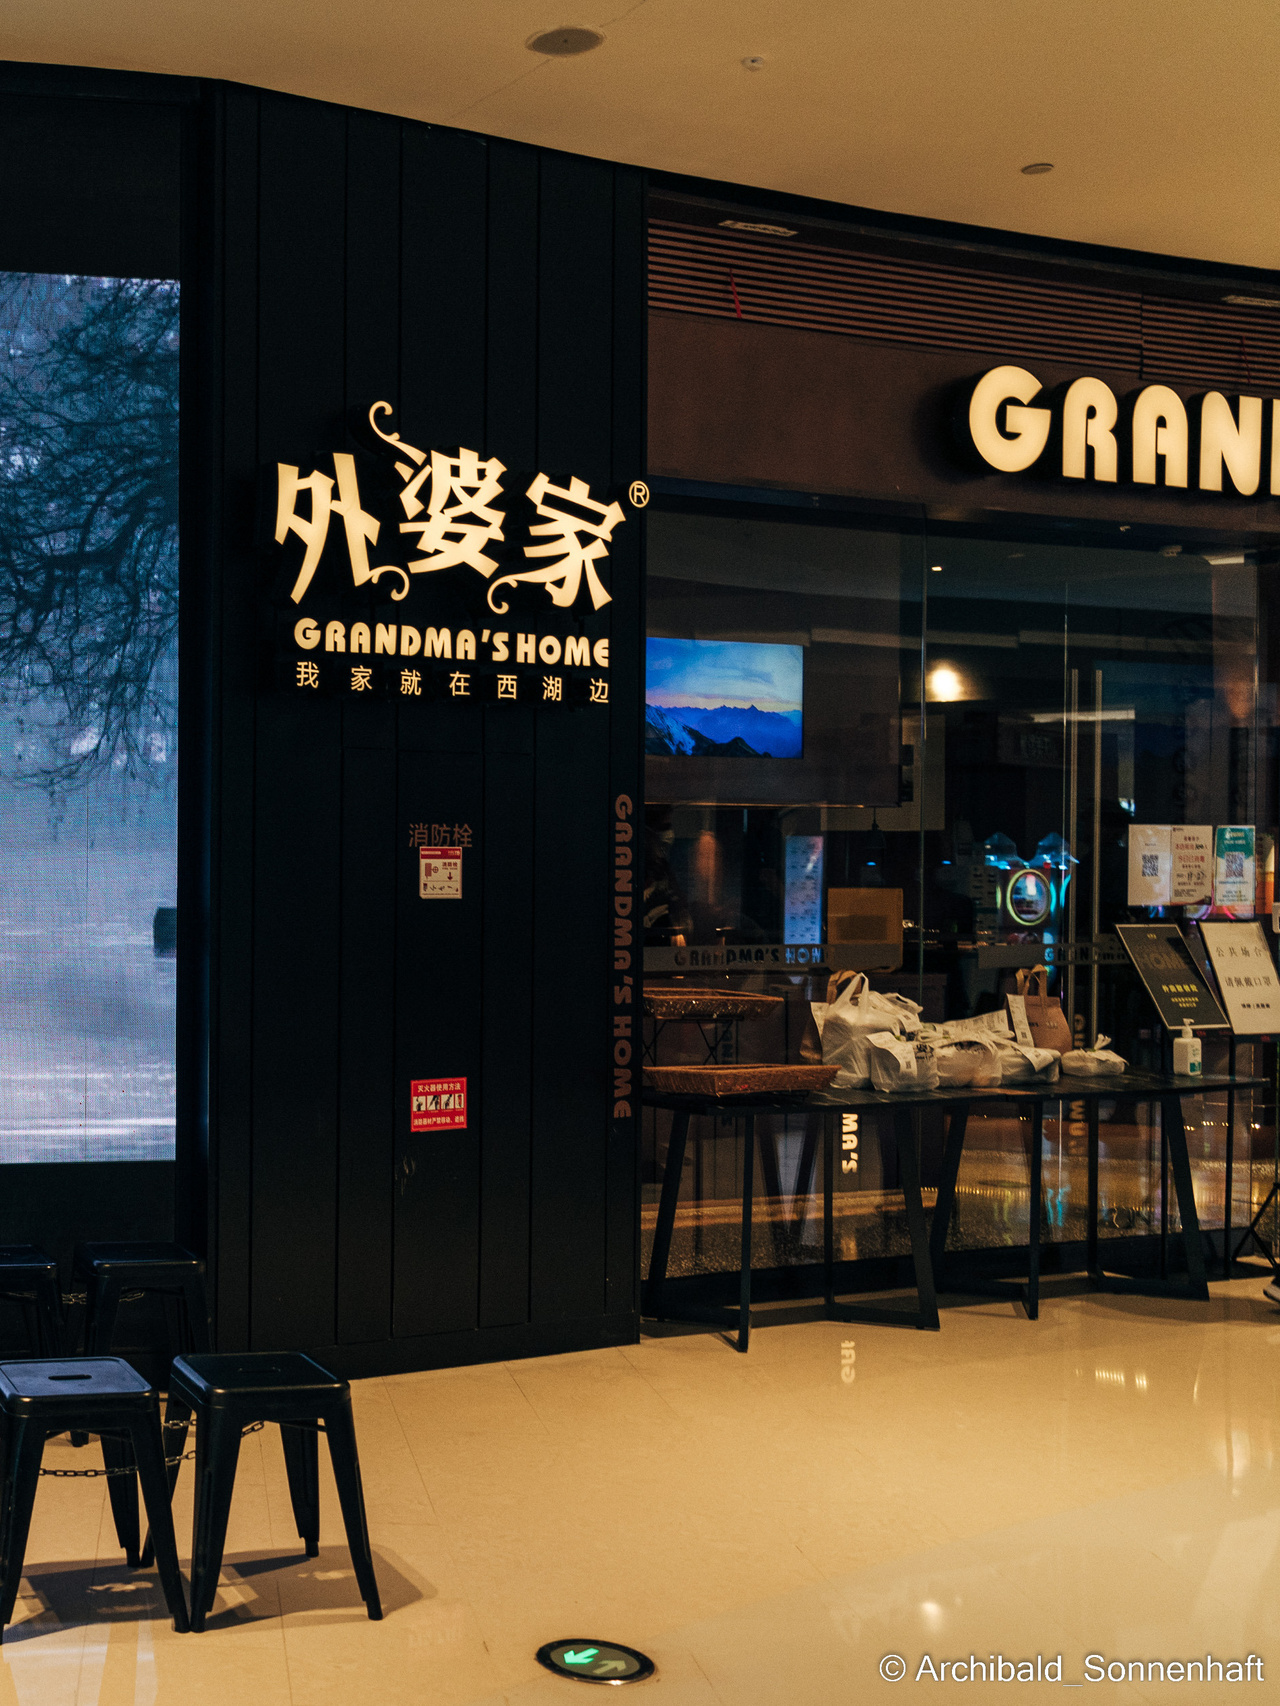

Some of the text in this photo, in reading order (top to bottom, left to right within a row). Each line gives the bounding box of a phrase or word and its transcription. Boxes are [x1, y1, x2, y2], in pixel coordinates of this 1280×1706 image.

[969, 365, 1280, 496] GRAN
[274, 401, 626, 614] 外婆家
[296, 661, 610, 704] 我家就在西湖边
[408, 823, 473, 848] 消防栓
[613, 794, 633, 1119] GRANDMA'S HOME
[784, 947, 827, 964] HOM
[417, 1082, 462, 1093] 灭火器使用方法
